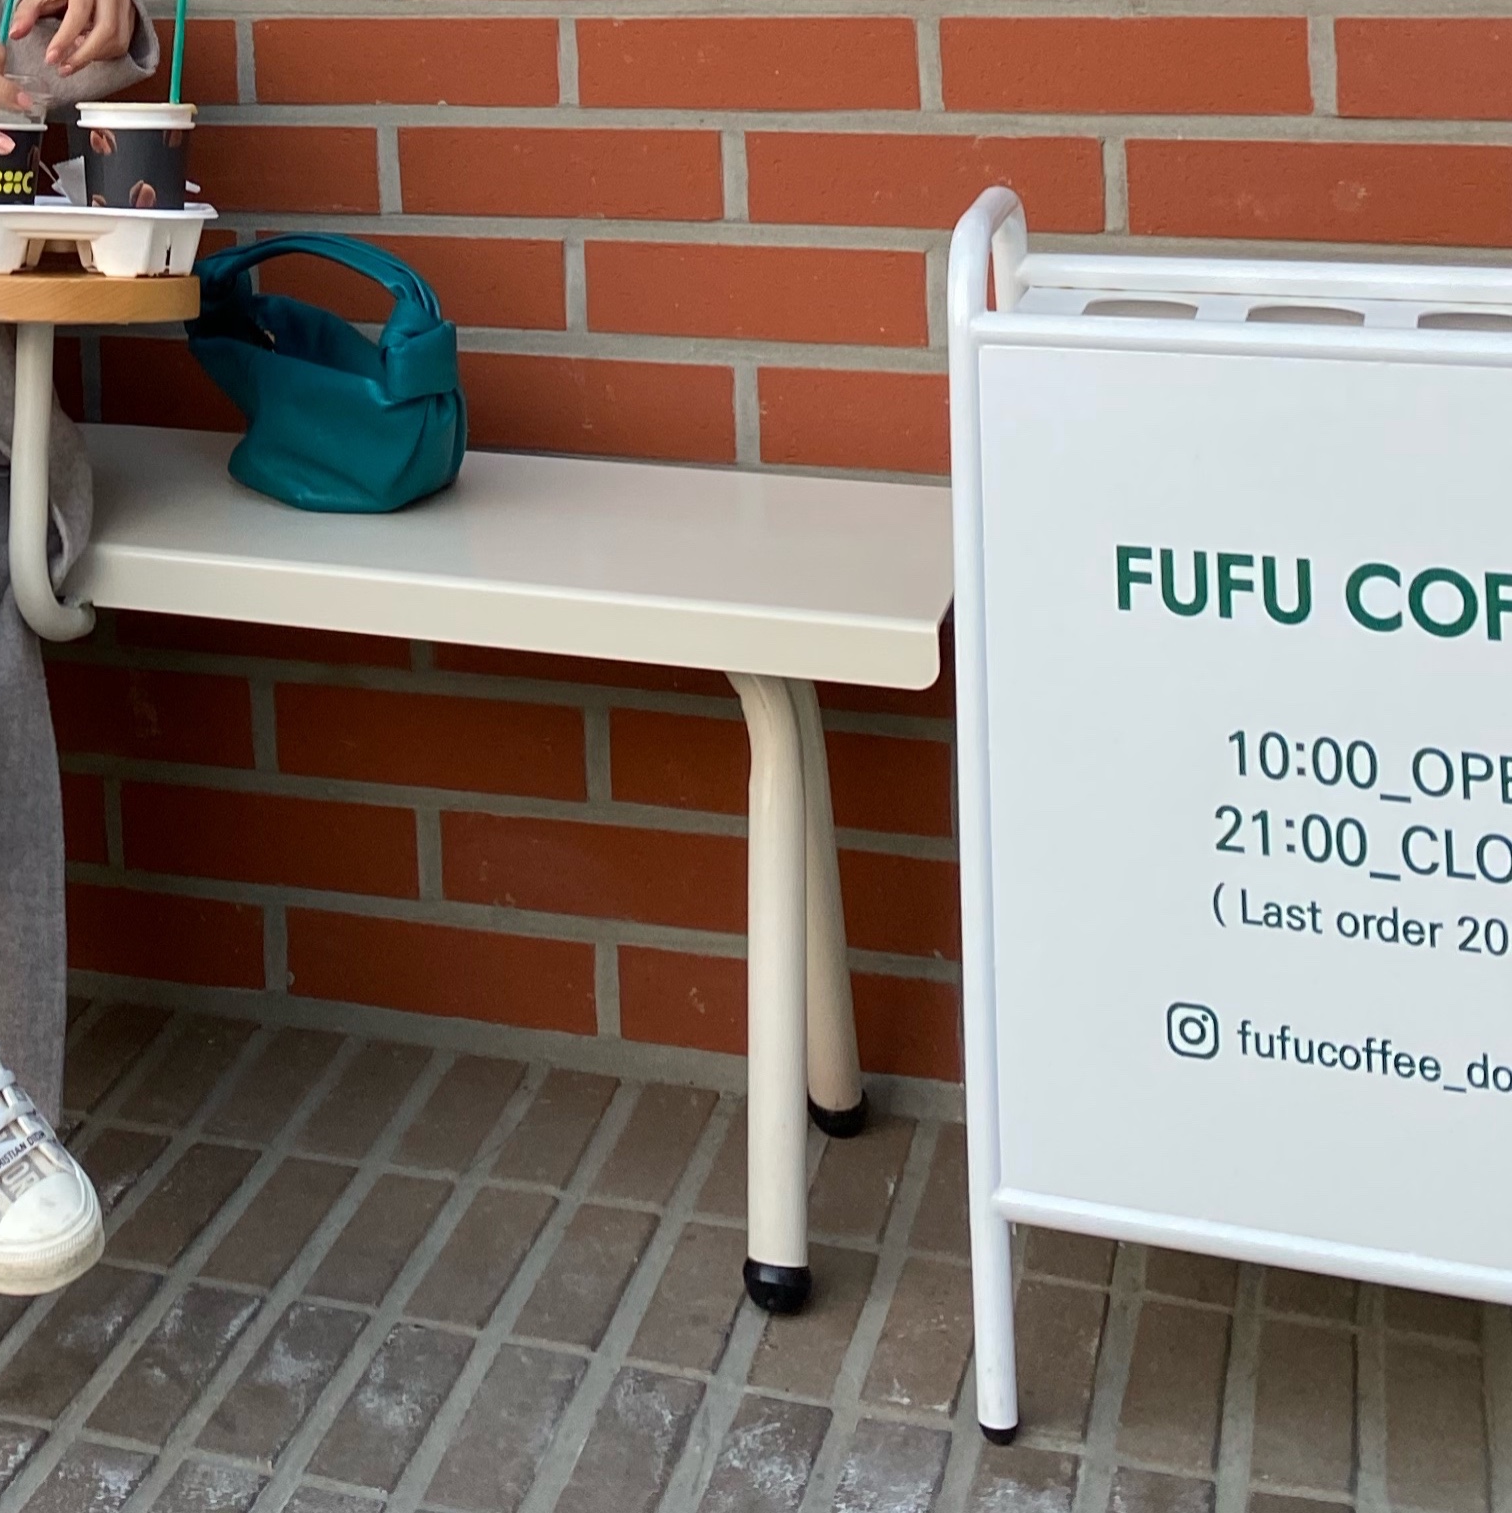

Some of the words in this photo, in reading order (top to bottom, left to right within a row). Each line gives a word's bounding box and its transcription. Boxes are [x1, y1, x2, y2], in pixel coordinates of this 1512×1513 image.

[1116, 544, 1312, 626] FUFU
[1336, 906, 1444, 949] order
[1457, 915, 1509, 957] 20
[1237, 1019, 1512, 1094] fufucoffee_do
